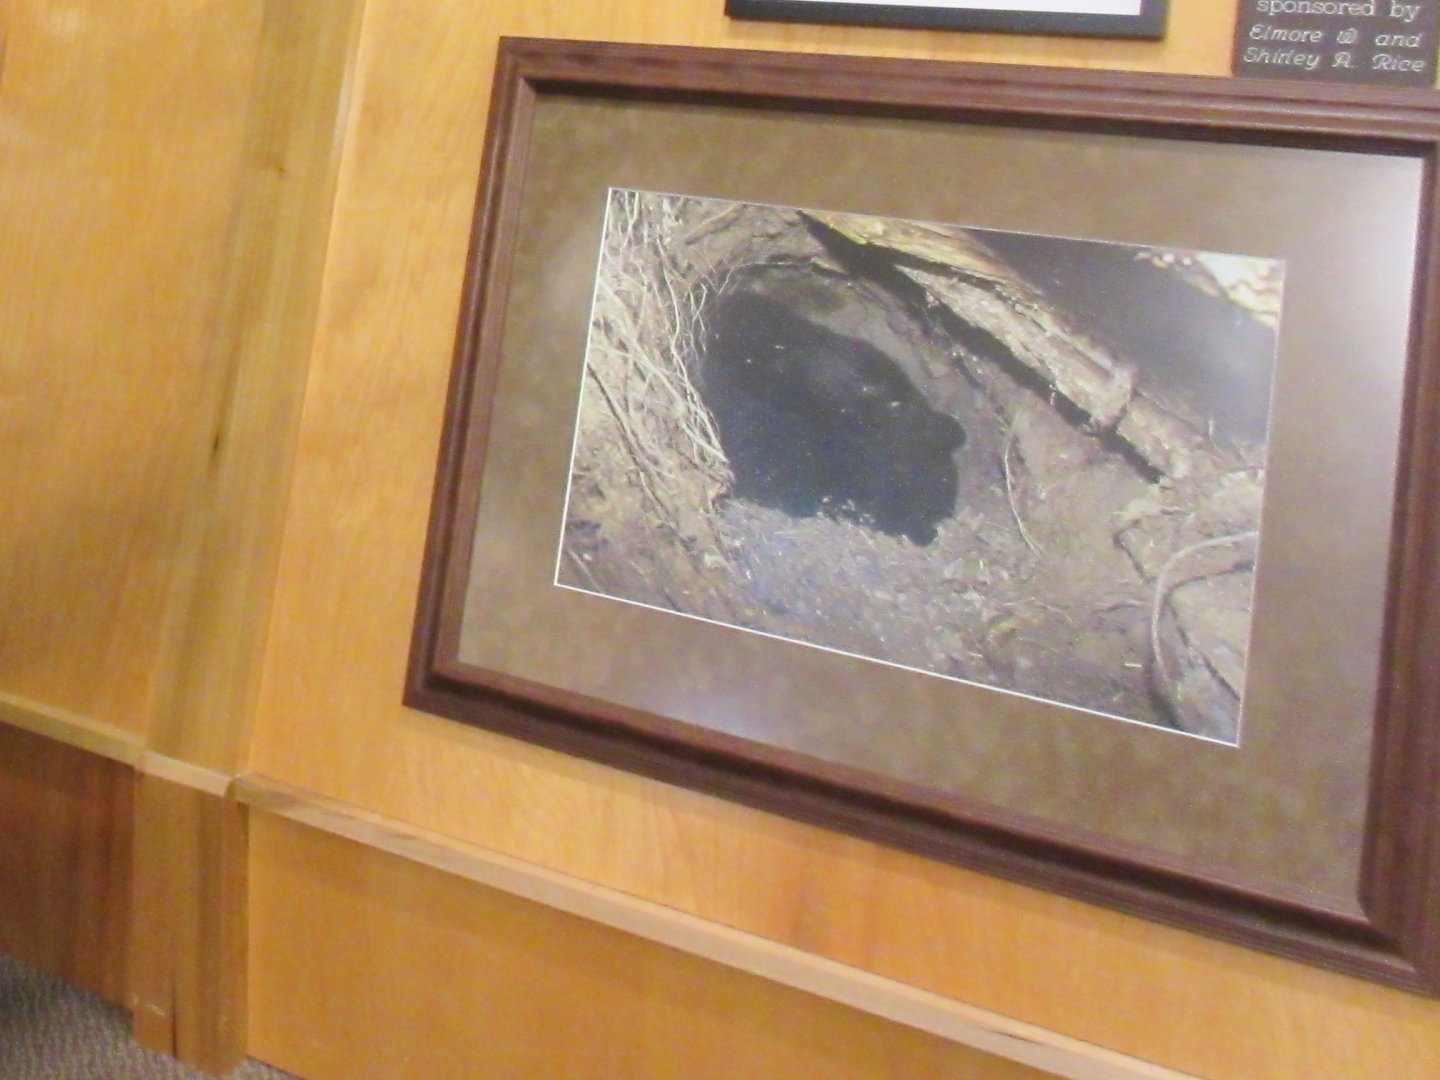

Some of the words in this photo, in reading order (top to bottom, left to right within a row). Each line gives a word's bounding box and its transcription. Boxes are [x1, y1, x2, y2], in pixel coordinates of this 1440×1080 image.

[1256, 0, 1376, 16] sponsored
[1389, 0, 1421, 23] by
[1249, 24, 1322, 43] Elmore
[1375, 32, 1422, 48] and
[1243, 47, 1320, 70] Shirley
[1372, 52, 1425, 72] Rice
